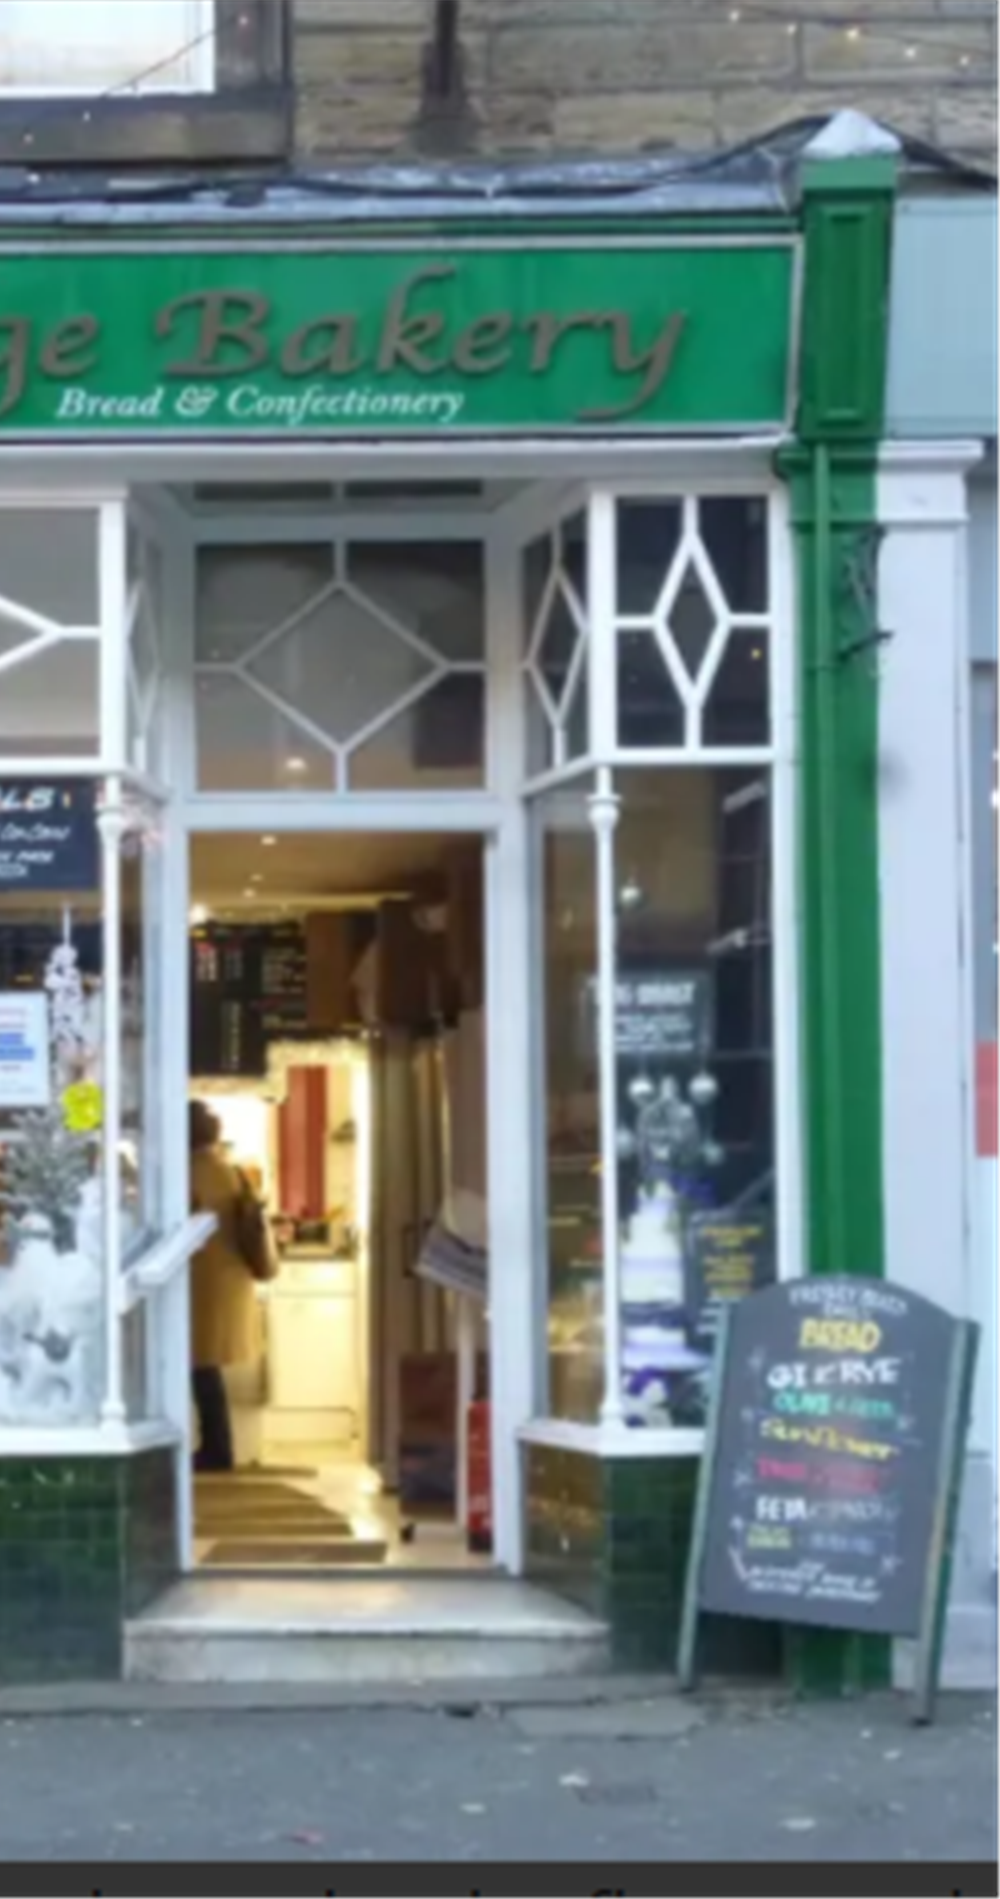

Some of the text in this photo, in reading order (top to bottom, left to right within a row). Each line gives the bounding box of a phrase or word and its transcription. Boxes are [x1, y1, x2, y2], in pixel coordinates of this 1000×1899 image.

[153, 262, 690, 423] Bakery
[56, 382, 466, 427] Bread & Confectionery
